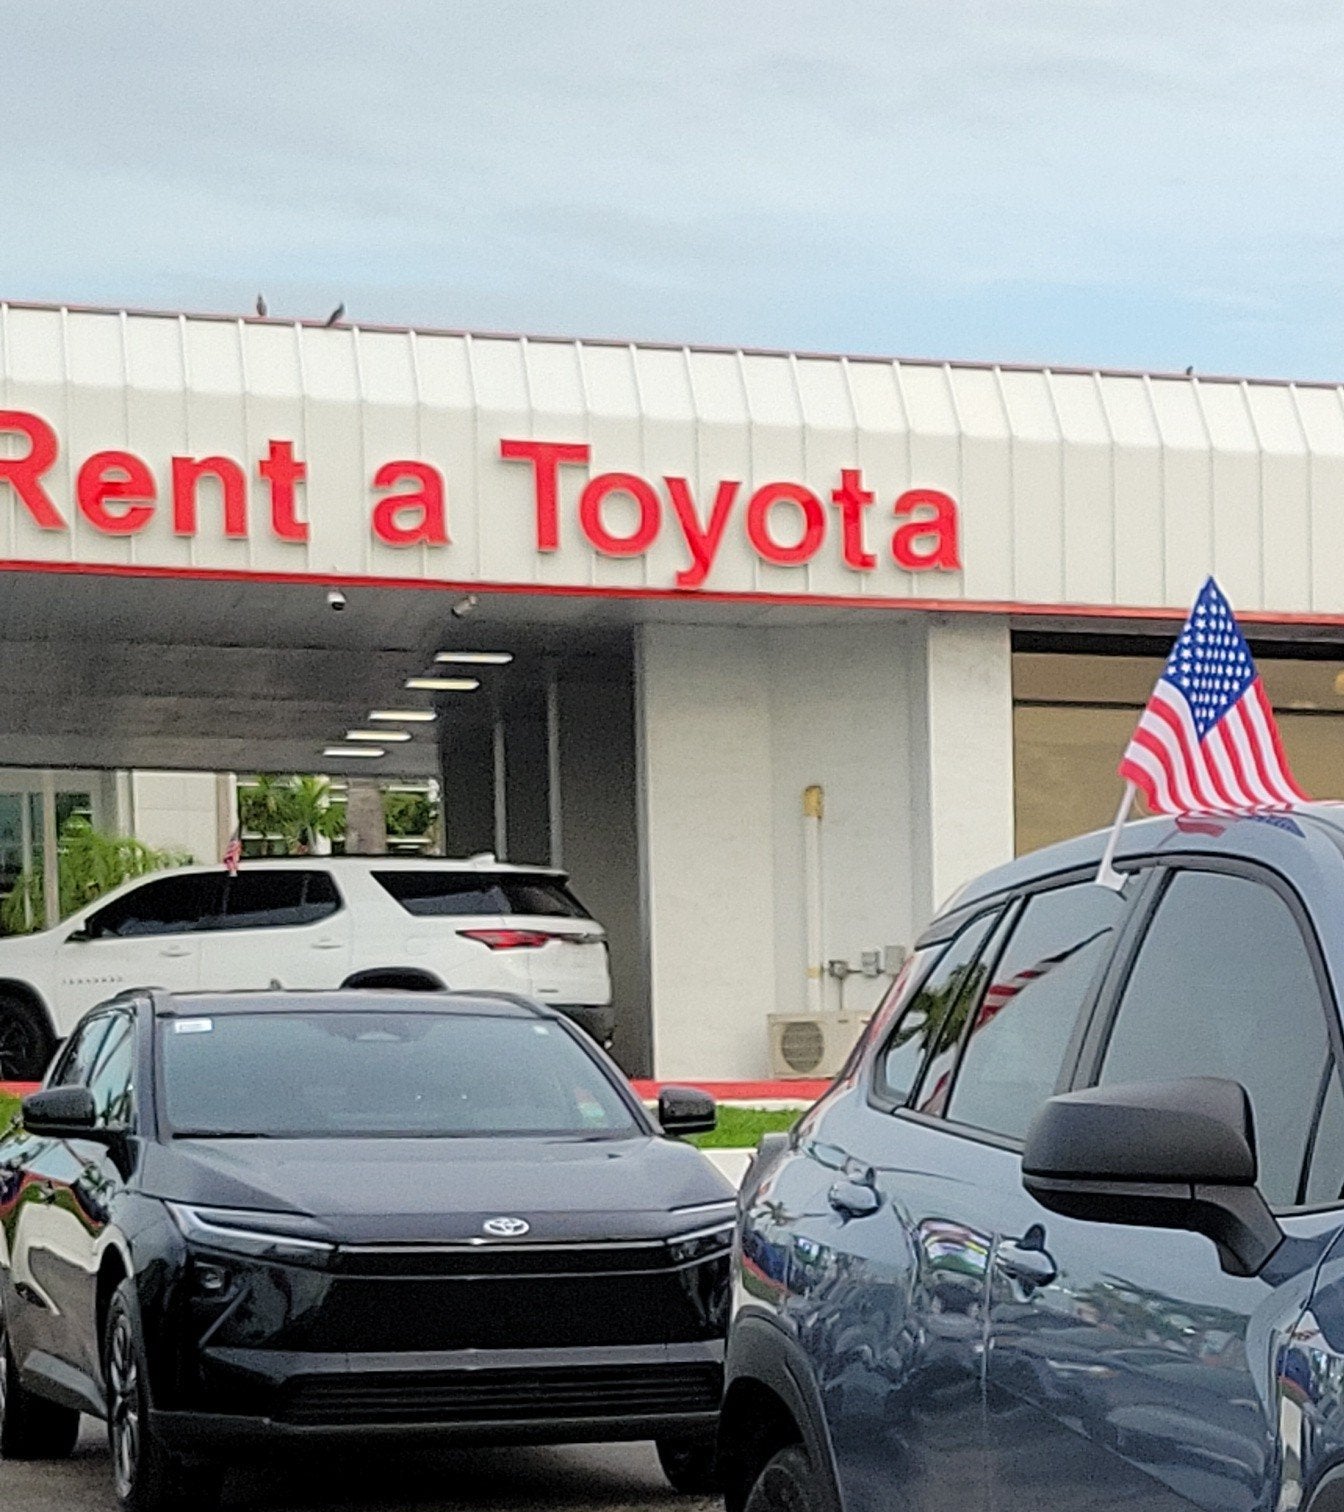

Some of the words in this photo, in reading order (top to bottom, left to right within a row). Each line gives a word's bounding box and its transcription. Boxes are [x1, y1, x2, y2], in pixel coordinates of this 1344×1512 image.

[0, 410, 310, 543] Rent
[371, 459, 452, 547] a
[500, 438, 961, 587] Toyota
